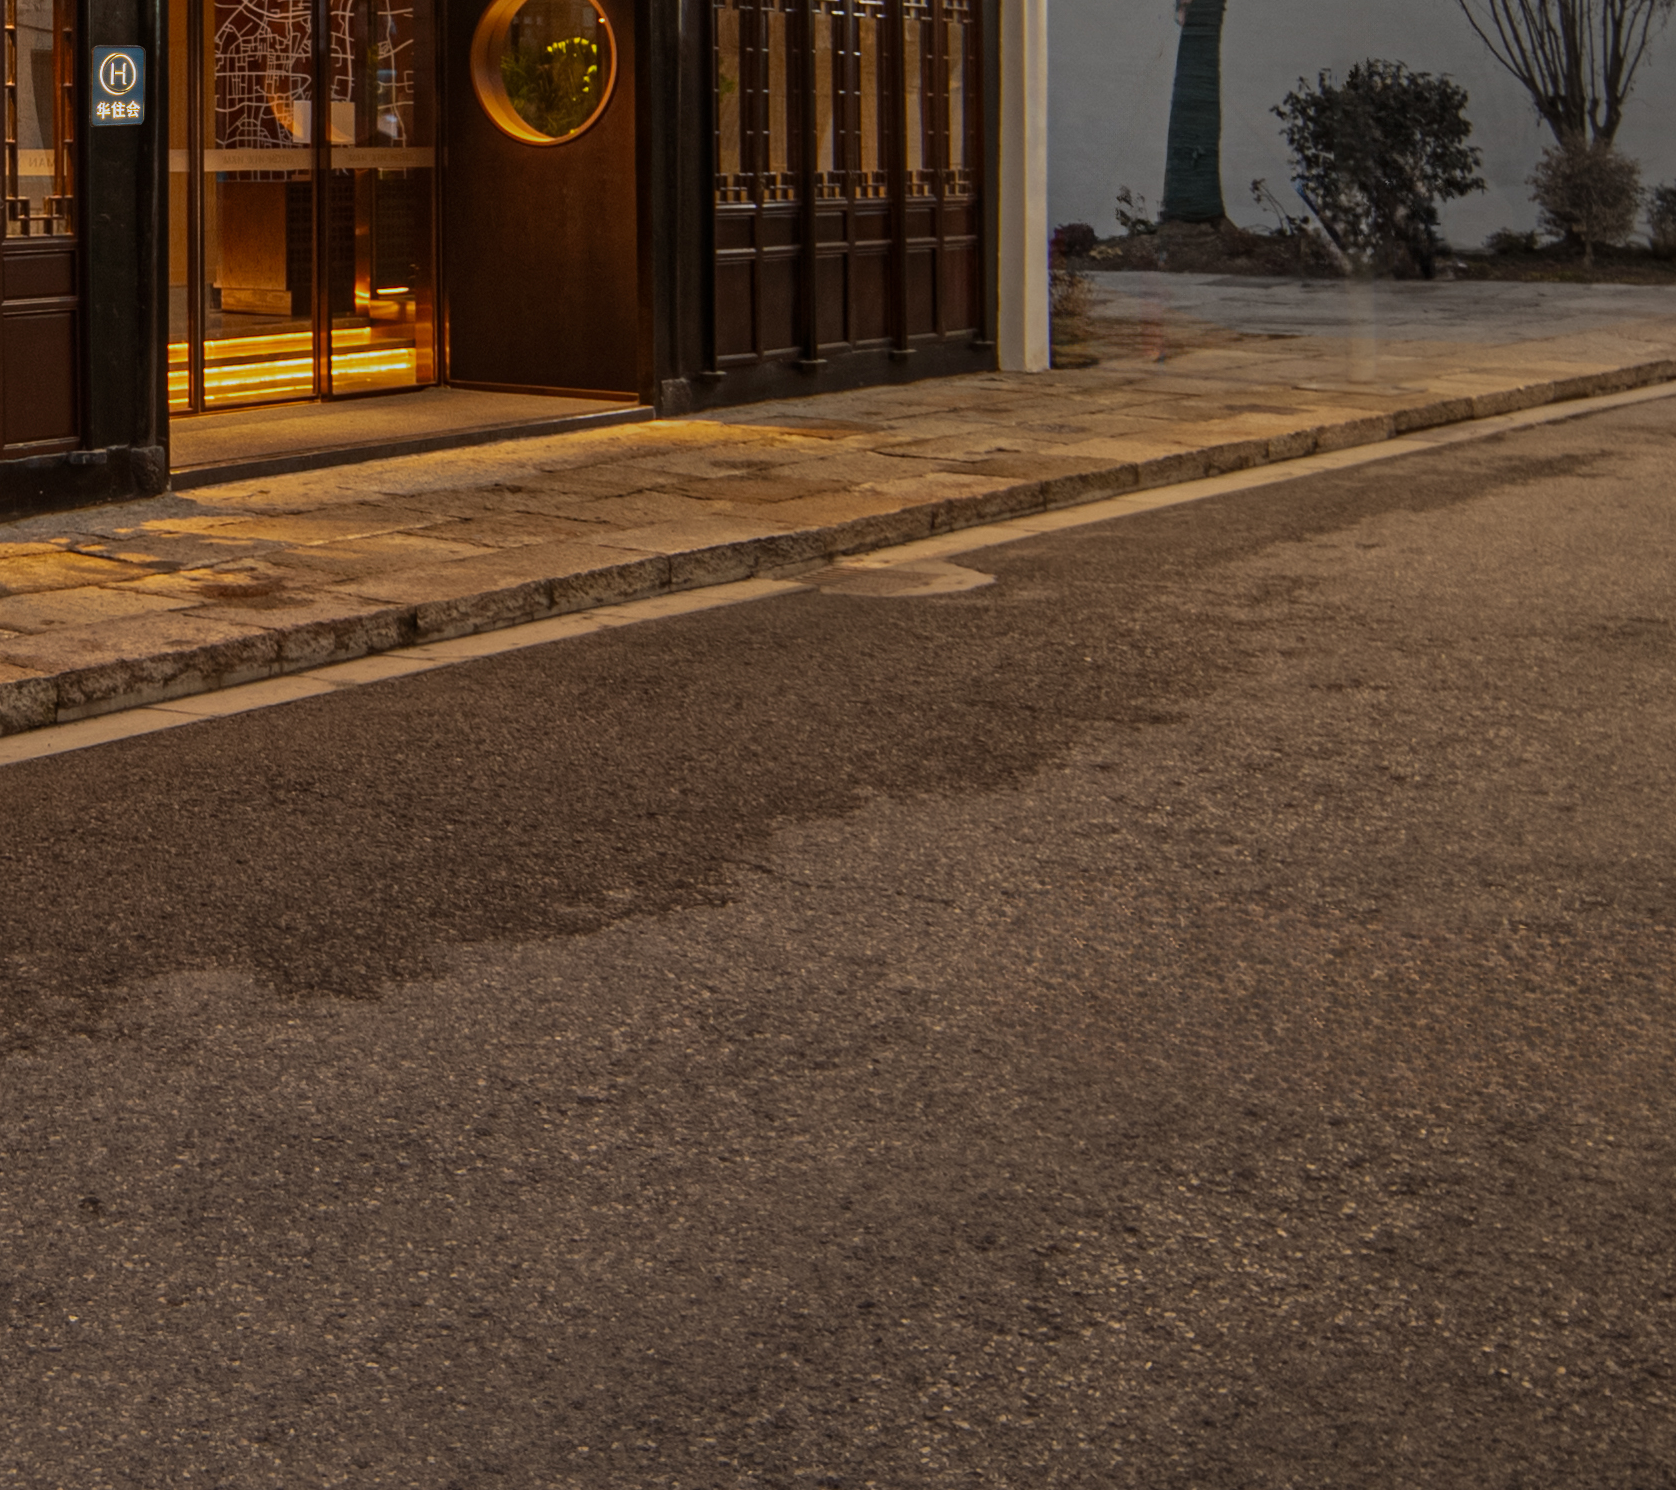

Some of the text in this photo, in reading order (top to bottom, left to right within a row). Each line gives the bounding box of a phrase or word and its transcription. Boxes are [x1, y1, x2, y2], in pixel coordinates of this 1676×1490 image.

[110, 62, 127, 86] H
[96, 100, 141, 120] 华住会
